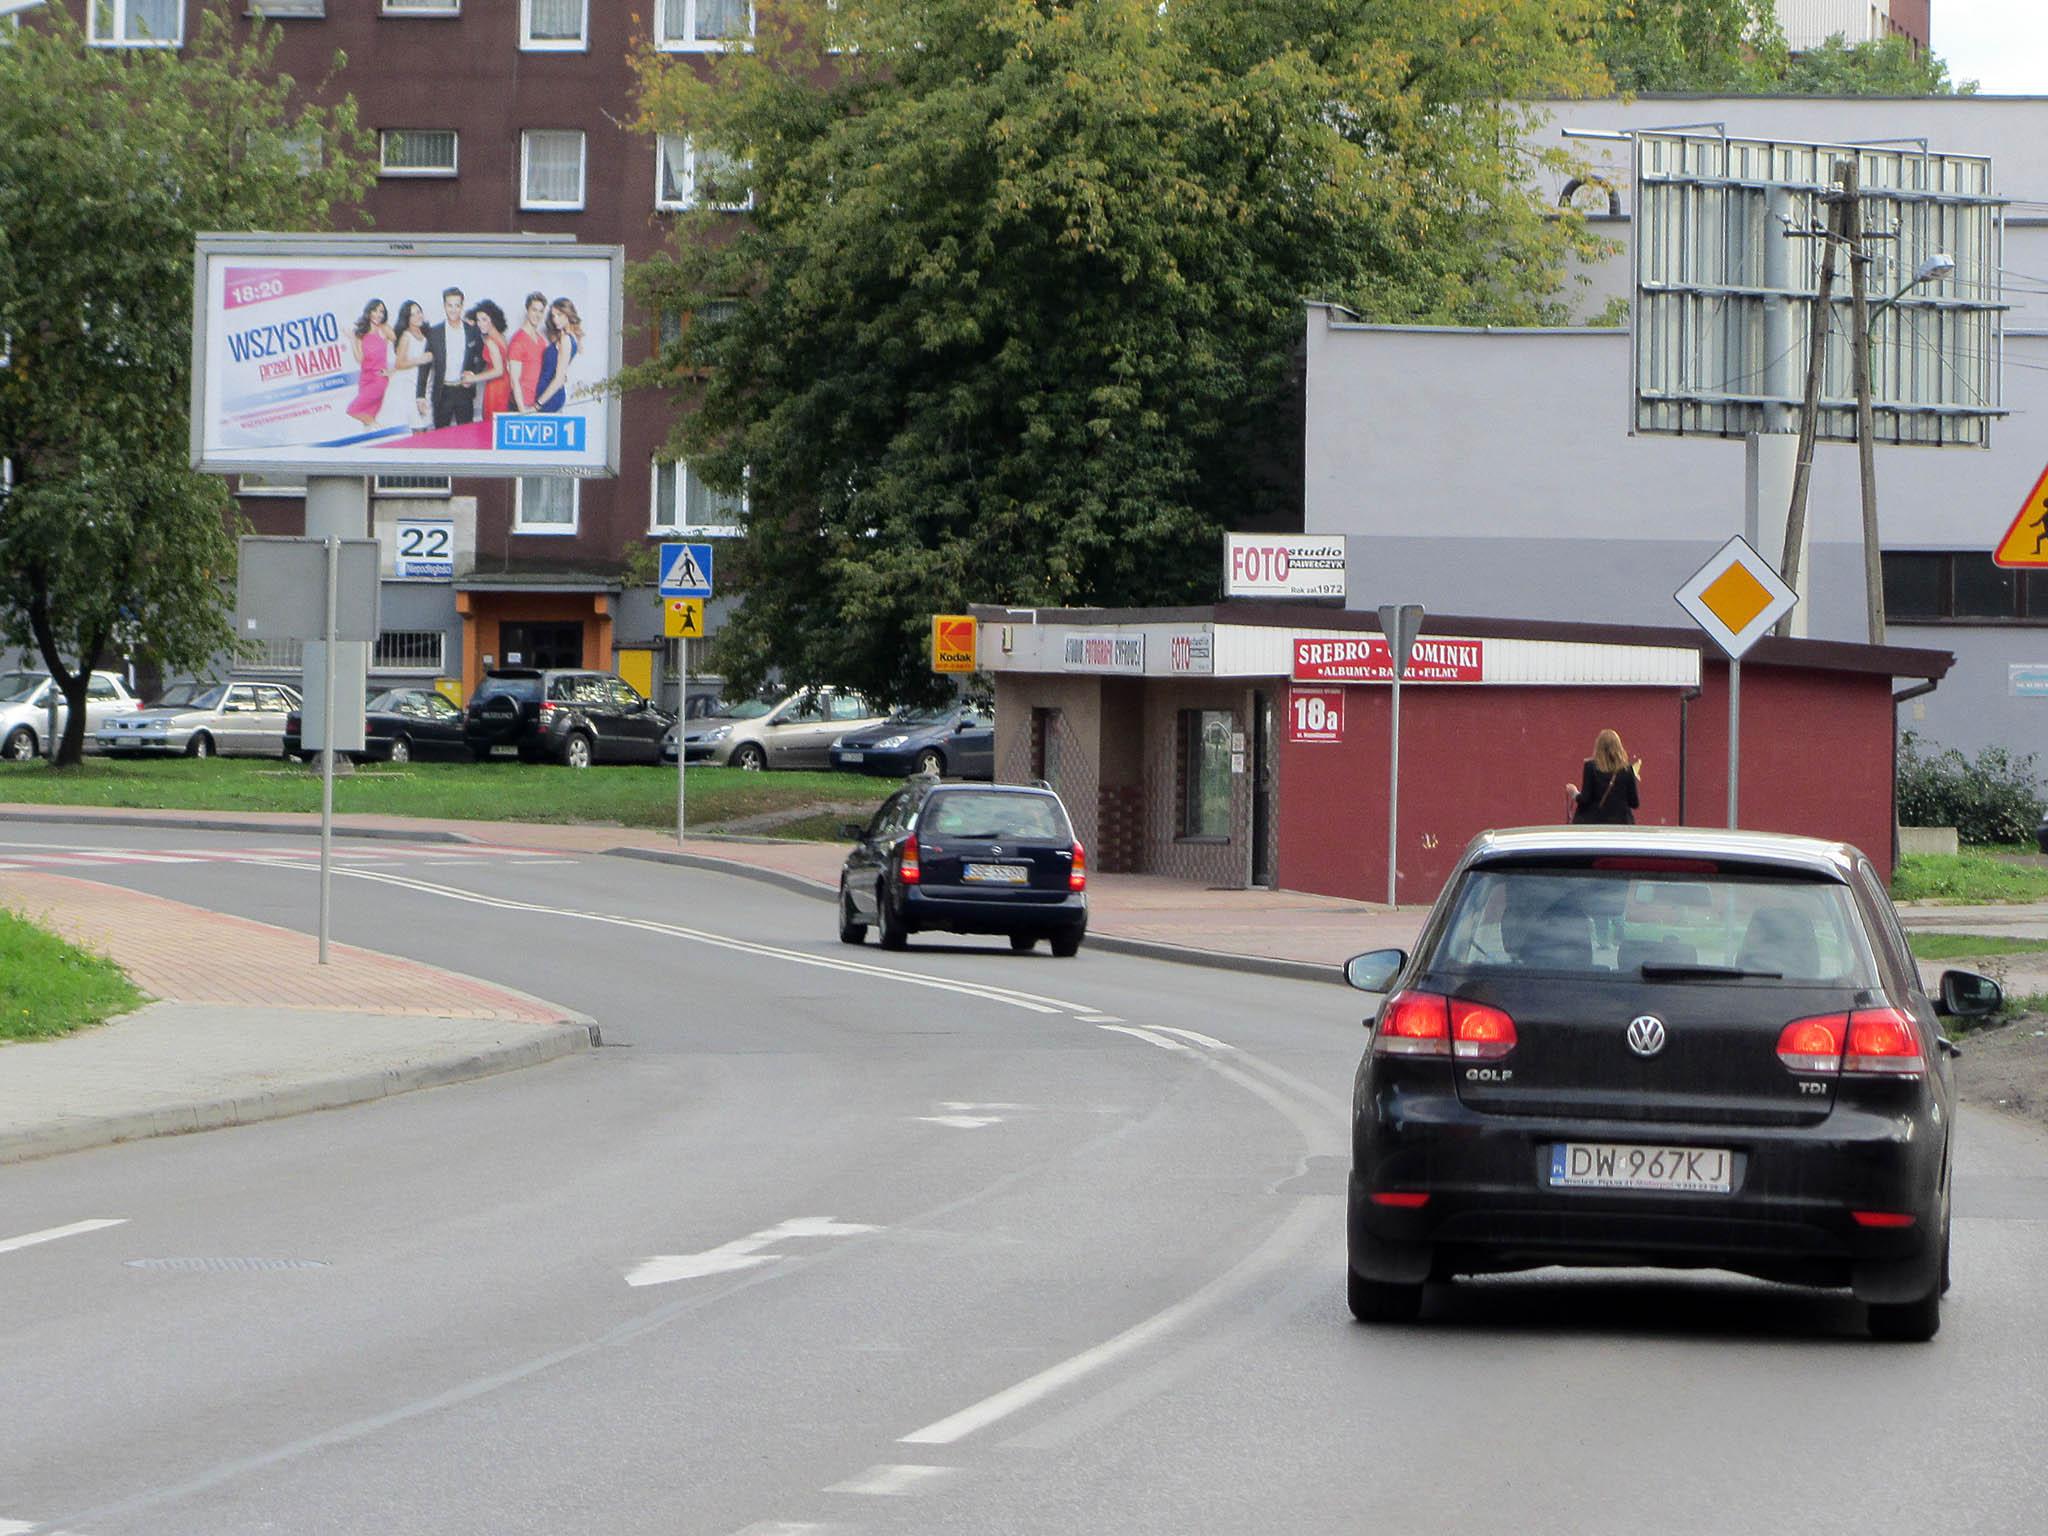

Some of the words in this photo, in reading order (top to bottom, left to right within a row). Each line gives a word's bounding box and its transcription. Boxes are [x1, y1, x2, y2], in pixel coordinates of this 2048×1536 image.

[231, 279, 283, 304] 18:20
[227, 312, 339, 362] WSZYSTKO
[258, 355, 293, 382] przed
[294, 344, 342, 377] NAMI
[507, 422, 555, 443] TVP
[563, 420, 576, 446] 1
[401, 527, 449, 558] 22
[1288, 547, 1343, 557] studio
[1232, 546, 1290, 582] FOTO
[1318, 584, 1343, 594] 1972
[939, 652, 972, 662] Kodak
[1298, 641, 1370, 665] SREBRO
[1378, 667, 1416, 678] RAKI
[1294, 697, 1338, 731] 18a
[1465, 1068, 1513, 1082] GOLF
[1799, 1081, 1827, 1095] TDI
[1571, 1147, 1617, 1178] DW
[1628, 1149, 1724, 1182] 967KJ
